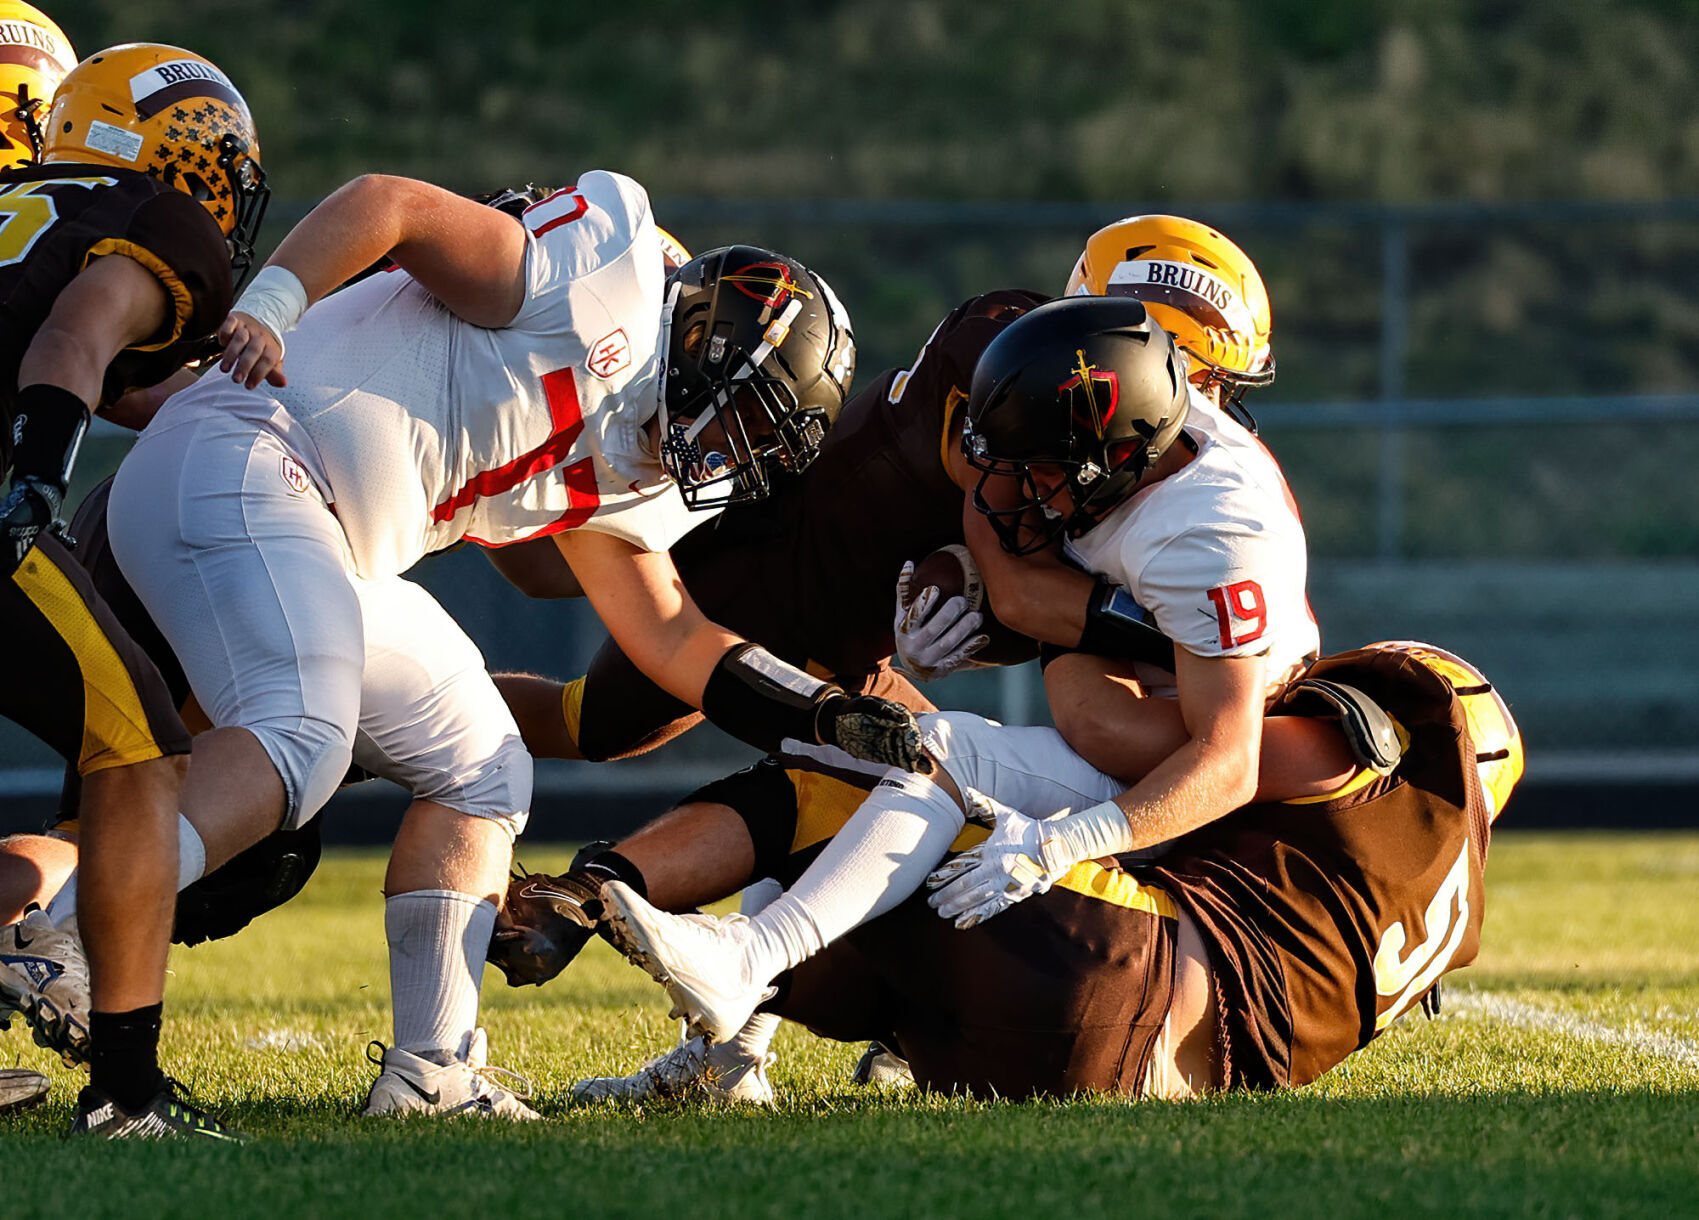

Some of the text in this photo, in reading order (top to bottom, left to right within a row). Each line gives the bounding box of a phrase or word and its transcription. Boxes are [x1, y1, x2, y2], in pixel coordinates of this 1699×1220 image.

[1147, 262, 1232, 310] BRUINS
[1206, 580, 1267, 650] 19
[87, 1102, 114, 1128] NIKE
